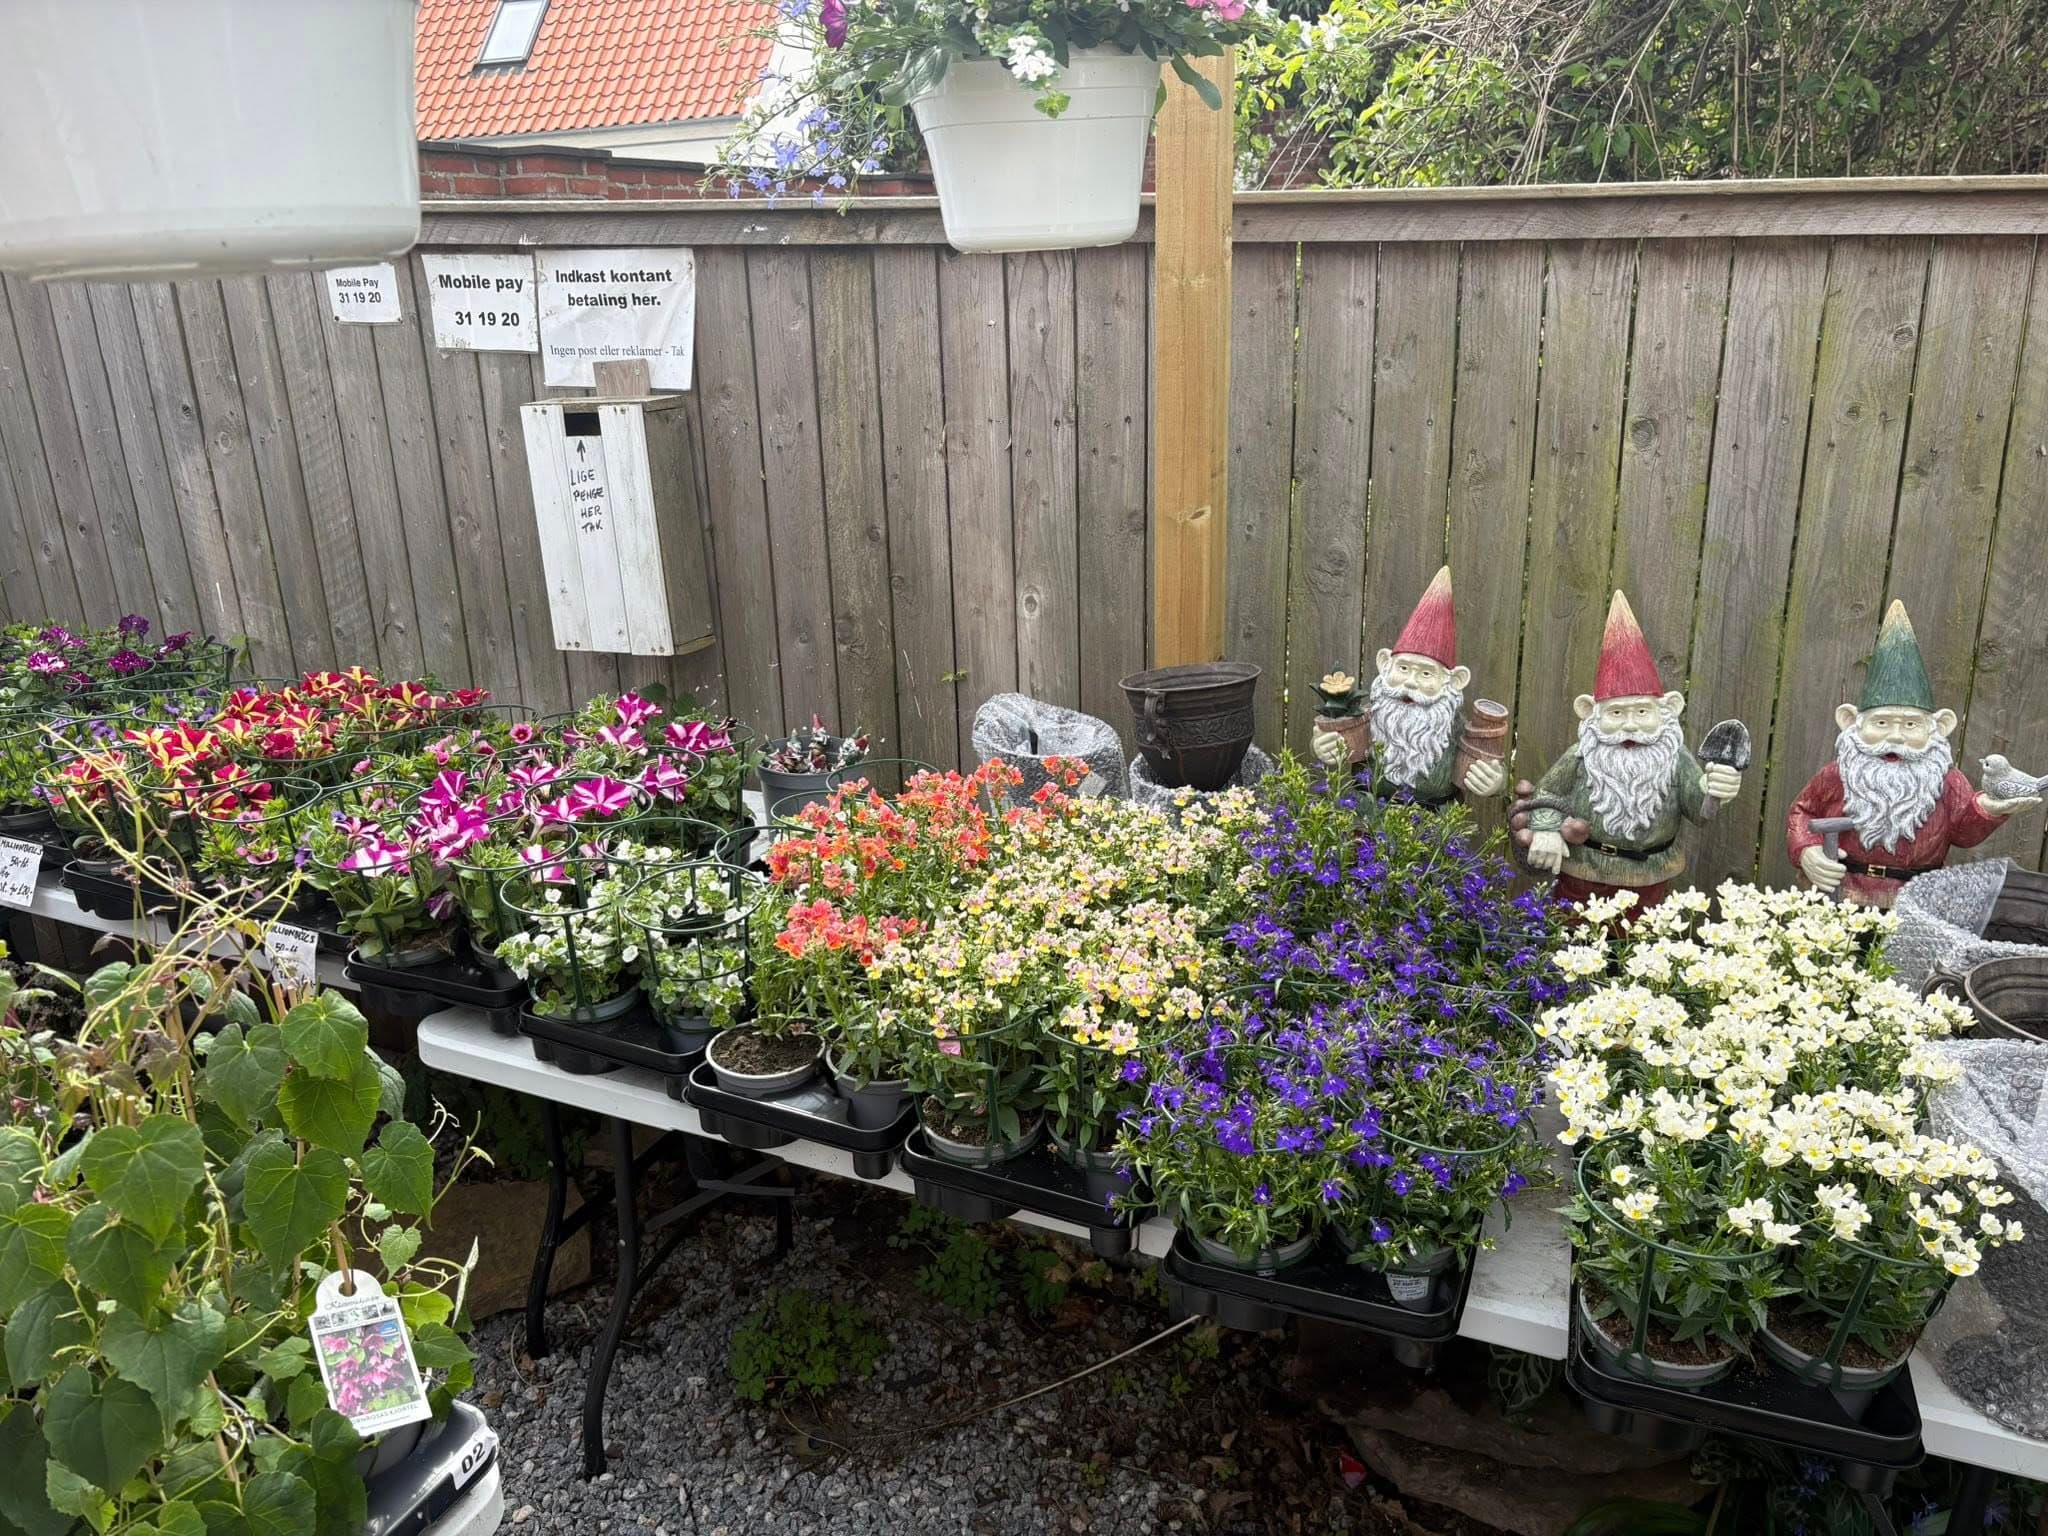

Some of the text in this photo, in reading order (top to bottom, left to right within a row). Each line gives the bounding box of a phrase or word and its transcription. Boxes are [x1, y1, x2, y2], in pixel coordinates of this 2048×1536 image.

[335, 277, 380, 290] Mobile Pay
[439, 274, 524, 293] Mobile pay
[555, 268, 673, 284] Indkast kontant
[339, 291, 382, 304] 31 19 20
[567, 292, 661, 309] betaling her.
[455, 311, 520, 327] 31 19 20
[550, 344, 576, 357] Ingen
[578, 346, 598, 358] post
[600, 345, 620, 357] eller
[621, 344, 663, 357] reklamer
[670, 344, 685, 356] Tak
[570, 469, 595, 486] LIGE
[573, 486, 605, 502] PENGE
[581, 505, 602, 518] HER
[581, 520, 603, 533] TAK
[461, 1443, 485, 1474] 02
